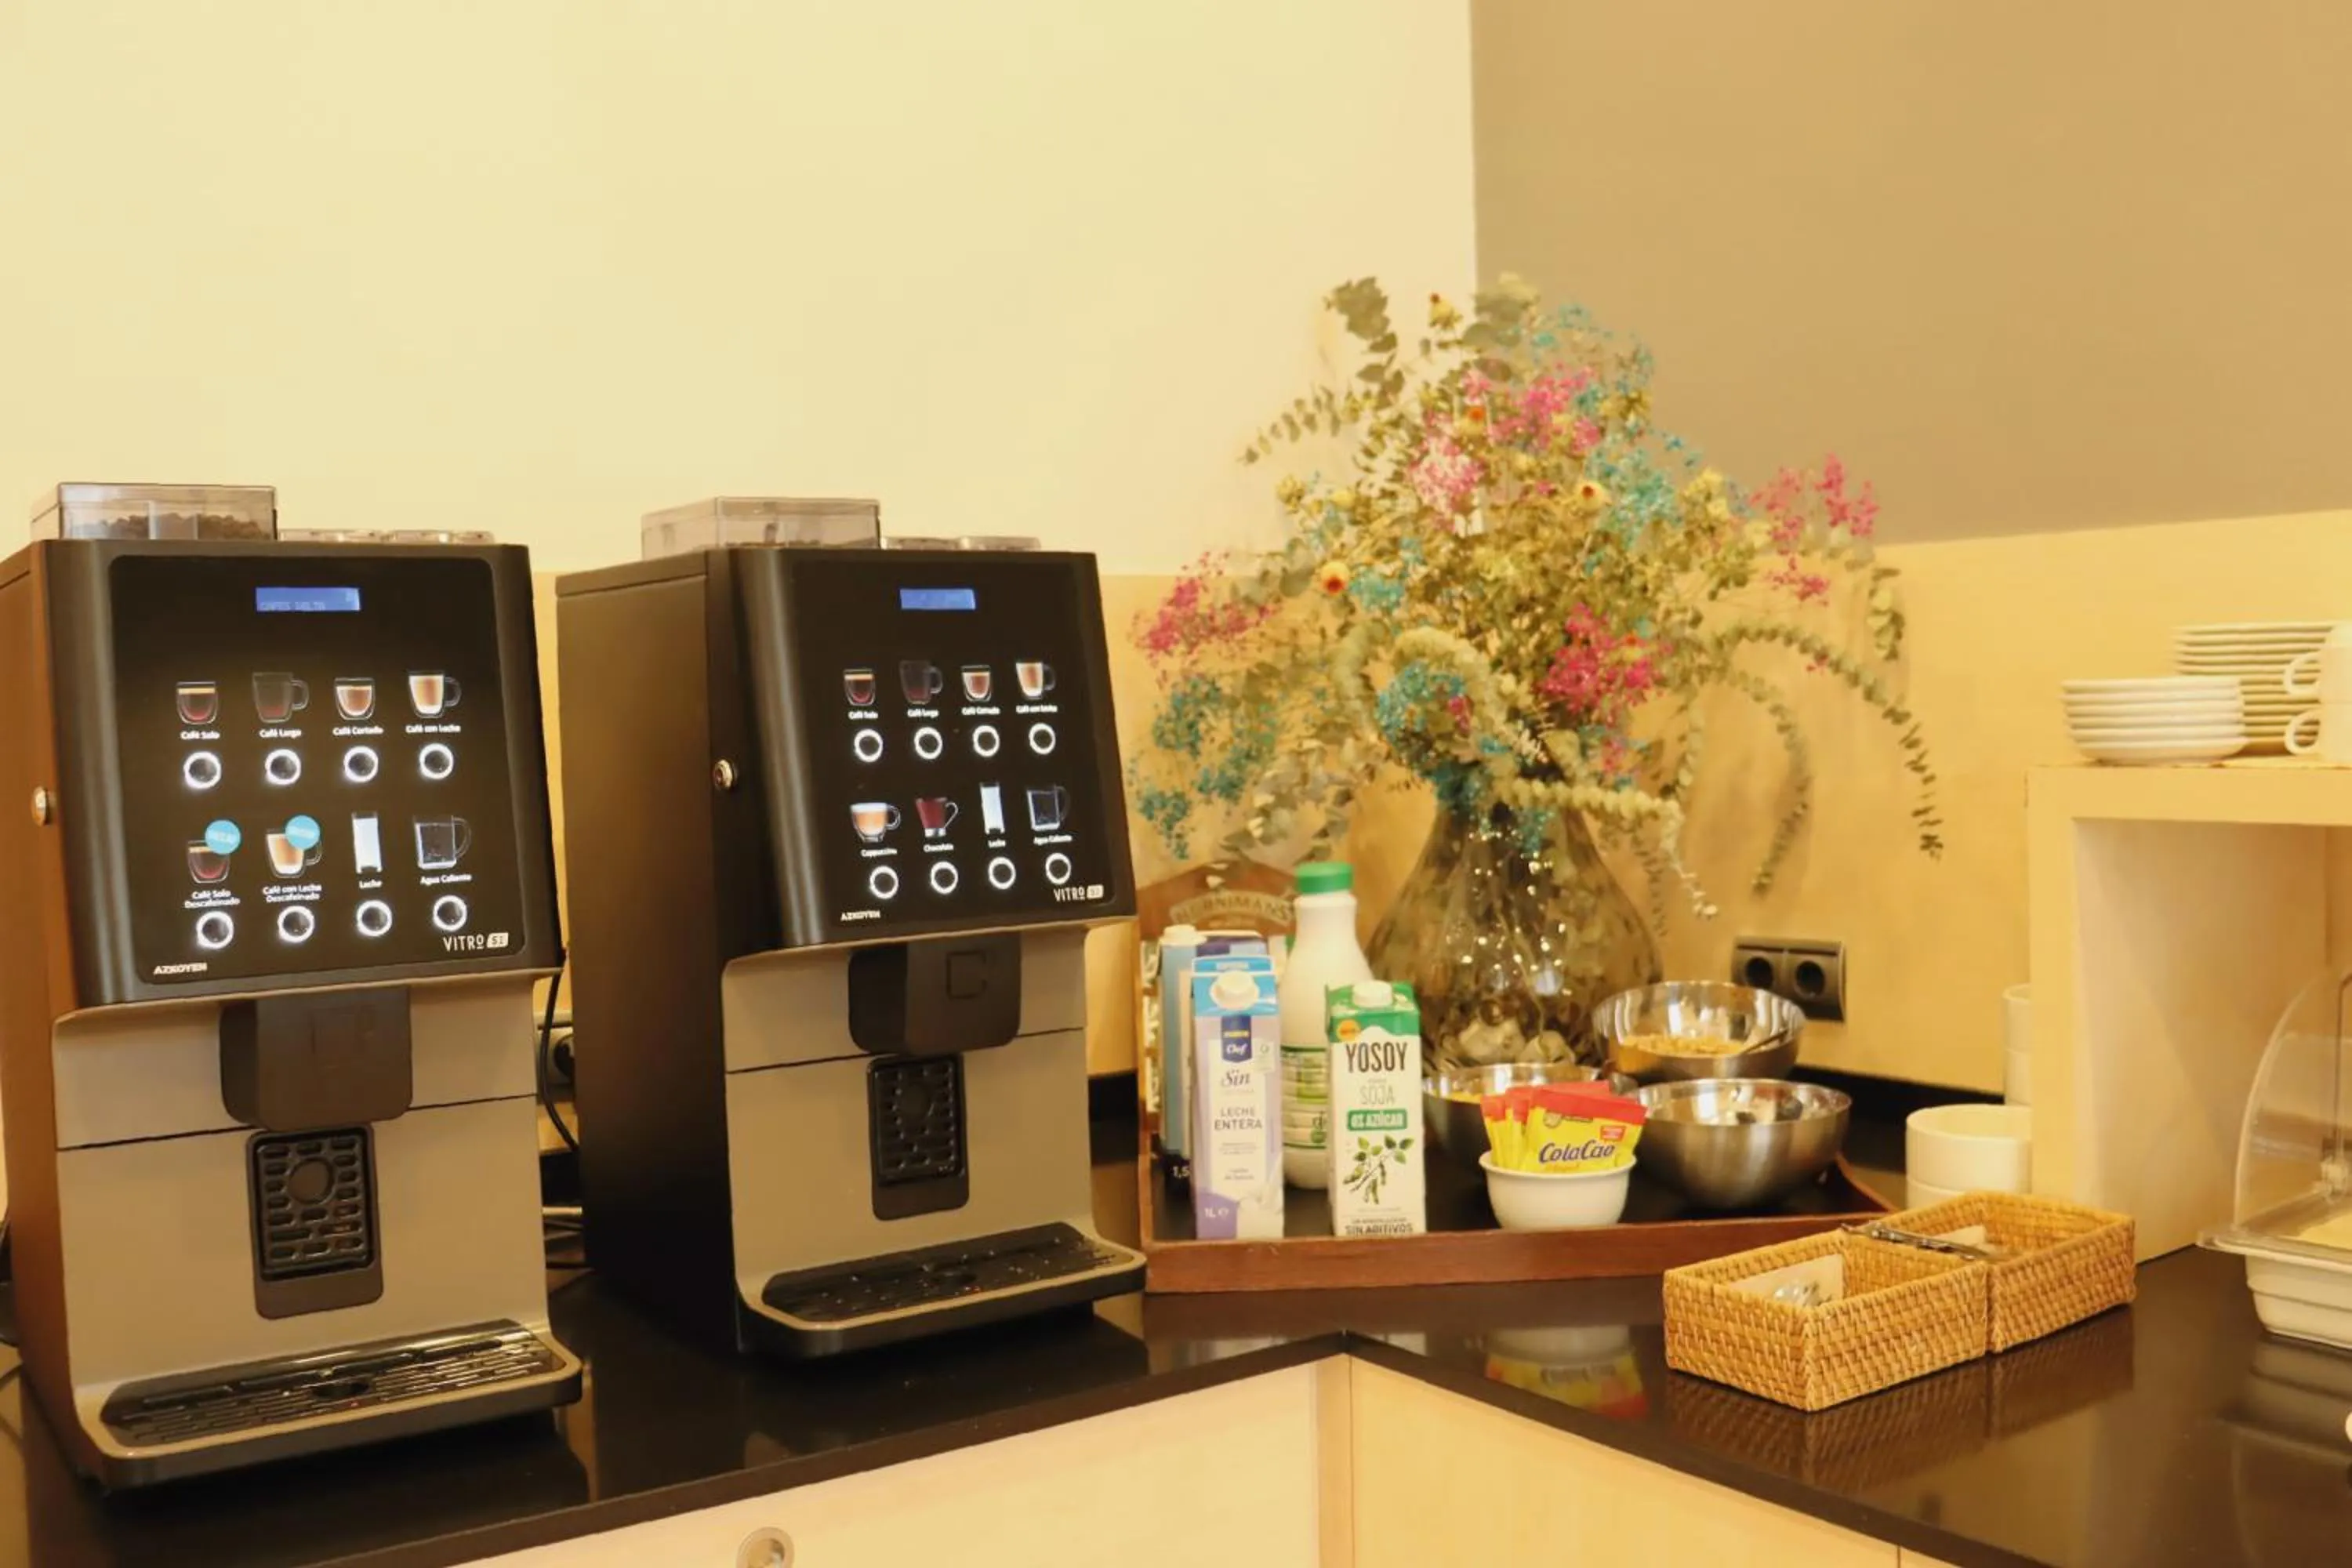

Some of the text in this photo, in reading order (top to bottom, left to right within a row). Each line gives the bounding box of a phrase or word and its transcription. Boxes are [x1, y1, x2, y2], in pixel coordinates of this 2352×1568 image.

[359, 880, 382, 889] Leche
[420, 877, 440, 886] Agua
[191, 888, 231, 899] Café Solo
[263, 886, 281, 895] Café
[1054, 887, 1085, 902] VITRO
[443, 935, 485, 952] VITRO
[154, 962, 207, 975] AZKOYEN
[1346, 1041, 1407, 1073] YOSOY
[1222, 1069, 1250, 1087] Sin
[1359, 1085, 1395, 1105] SOJA
[1221, 1107, 1254, 1117] LECHE
[1214, 1120, 1262, 1131] ENTERA
[1539, 1139, 1615, 1163] ColaCao
[1172, 1166, 1189, 1178] 1,5
